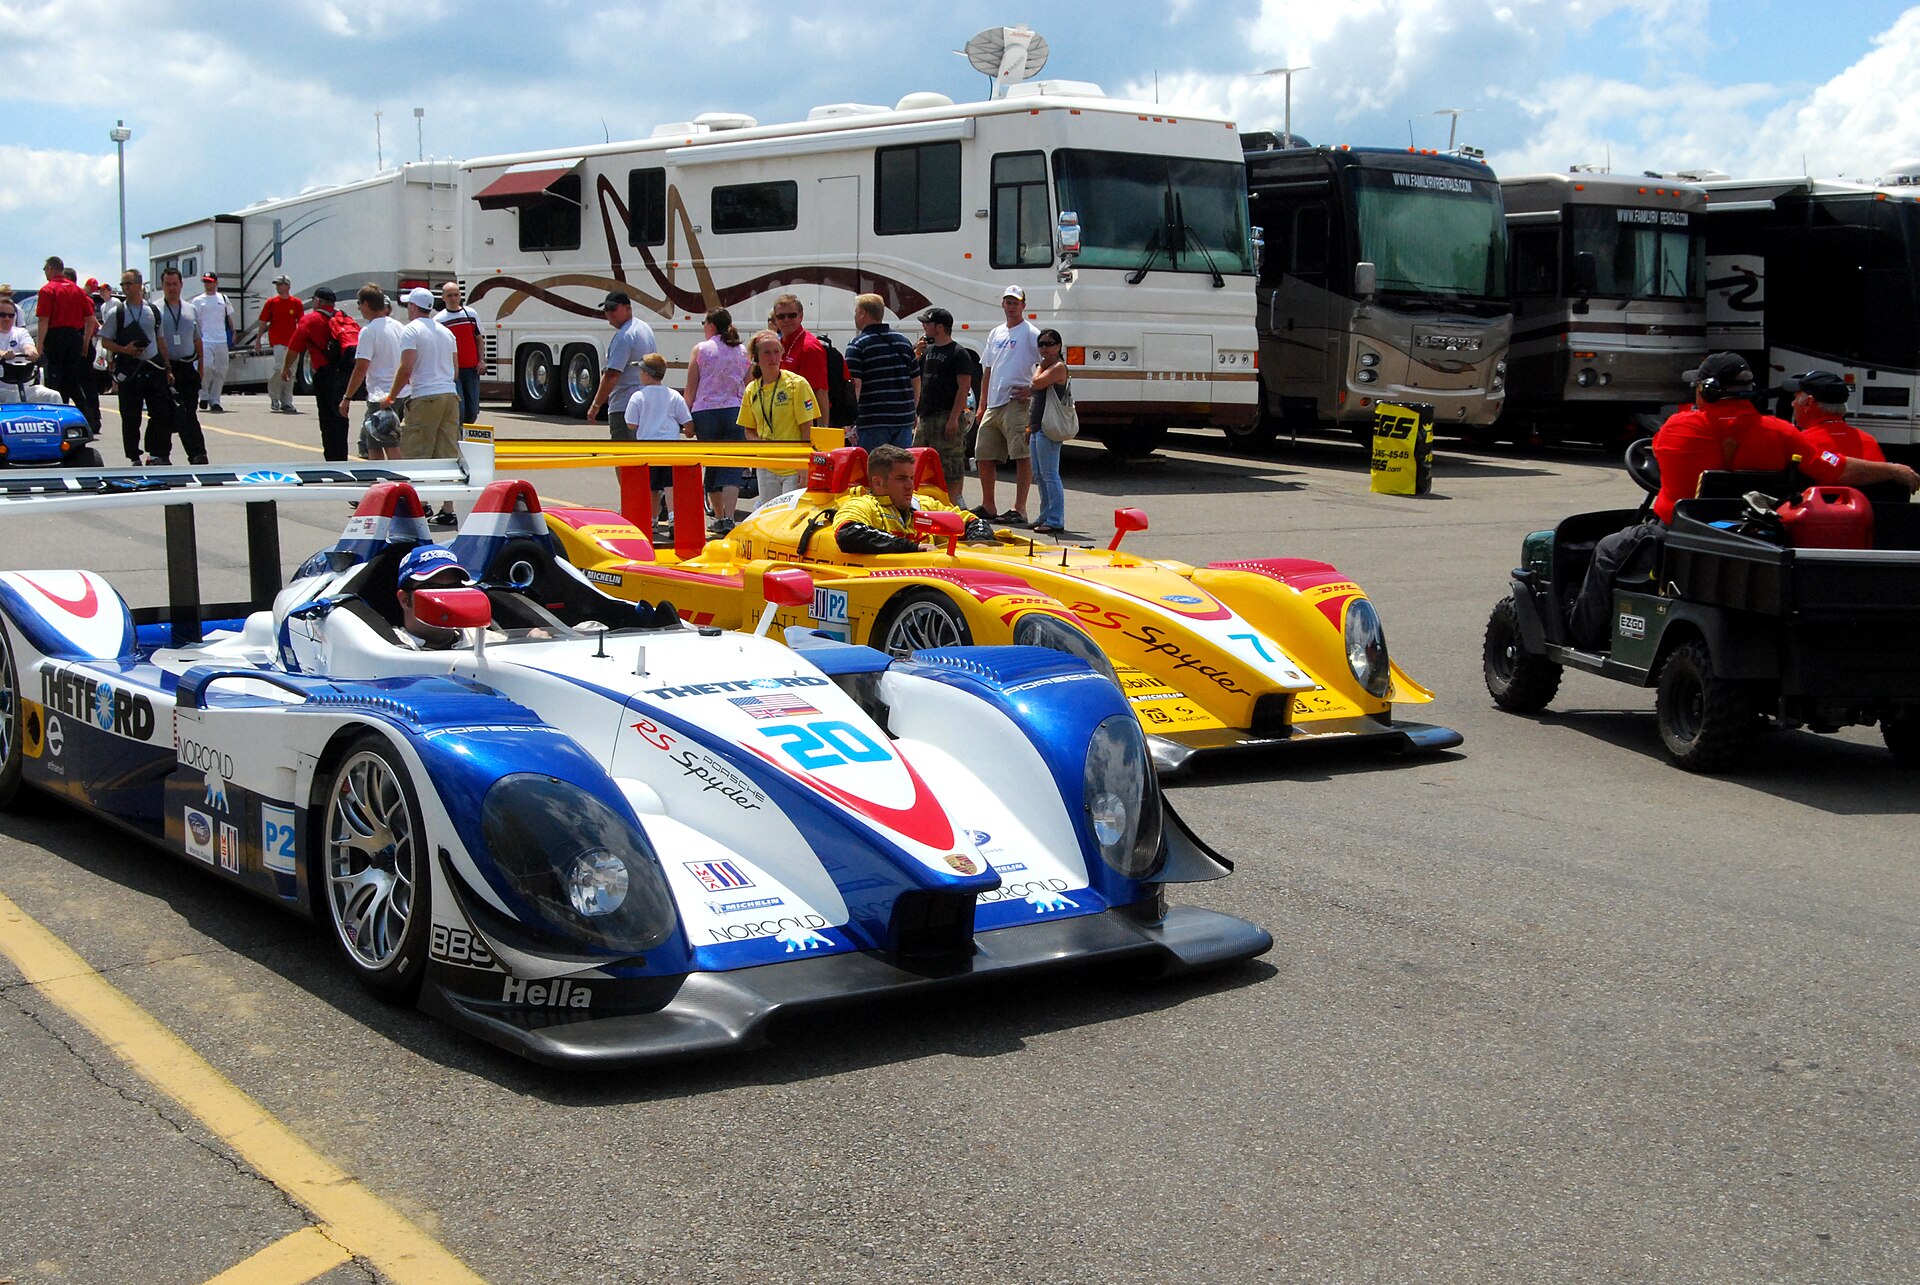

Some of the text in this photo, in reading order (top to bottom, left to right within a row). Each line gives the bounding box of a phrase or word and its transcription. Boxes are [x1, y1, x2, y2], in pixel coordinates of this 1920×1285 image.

[1392, 172, 1473, 193] WWW.FAMILYRVRENTALS.COM
[6, 420, 55, 434] LOWE'S
[586, 570, 622, 584] MICHELIN
[1318, 584, 1357, 594] DHL
[829, 594, 846, 619] P2
[1006, 597, 1051, 605] DHL
[751, 608, 799, 632] HATT
[1068, 600, 1251, 697] RS Spyder
[1226, 633, 1276, 663] 7
[39, 661, 156, 742] THETFORD
[643, 675, 831, 700] THETFORD
[1138, 692, 1185, 700] MICHELIN
[630, 718, 677, 751] RS
[757, 720, 893, 770] 20
[177, 736, 234, 780] NORCOLD
[669, 750, 761, 810] Spyder
[702, 754, 765, 803] PORSCHE
[265, 820, 296, 859] P2
[725, 898, 780, 911] MICHELIN
[708, 914, 826, 942] NORCOLD
[430, 924, 494, 967] BBS
[501, 974, 593, 1009] Hella
